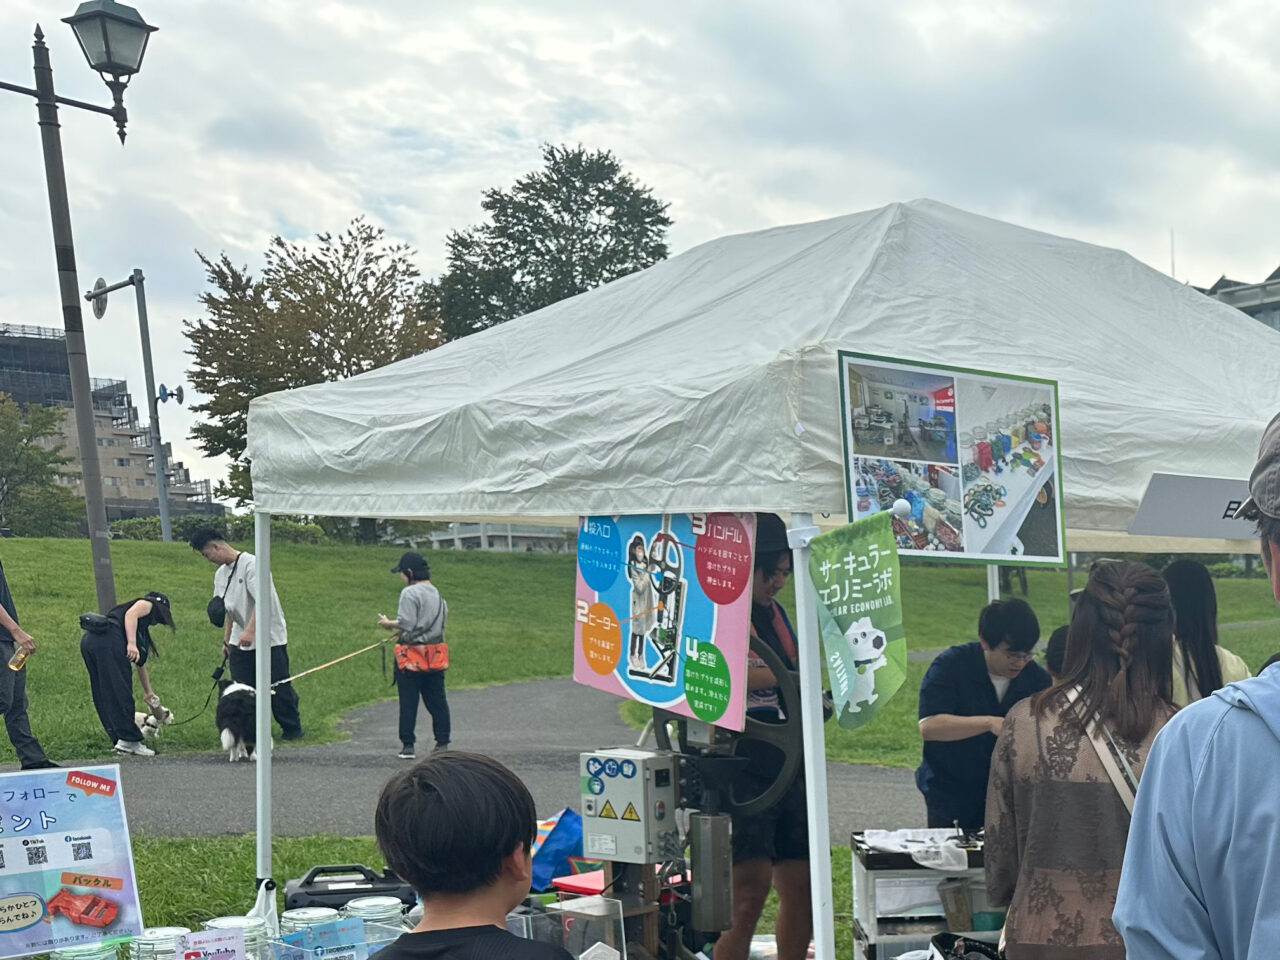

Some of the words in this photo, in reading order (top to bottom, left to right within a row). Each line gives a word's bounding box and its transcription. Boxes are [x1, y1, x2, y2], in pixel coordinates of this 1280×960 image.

[707, 523, 743, 543] ハンドル
[819, 543, 891, 583] サーキュラー
[819, 567, 892, 605] エコノミーラボ
[850, 597, 883, 614] ECONOMY
[588, 612, 617, 630] ヒーター
[71, 775, 99, 789] FOLLOW
[99, 783, 111, 792] ME
[72, 876, 112, 888] バックル
